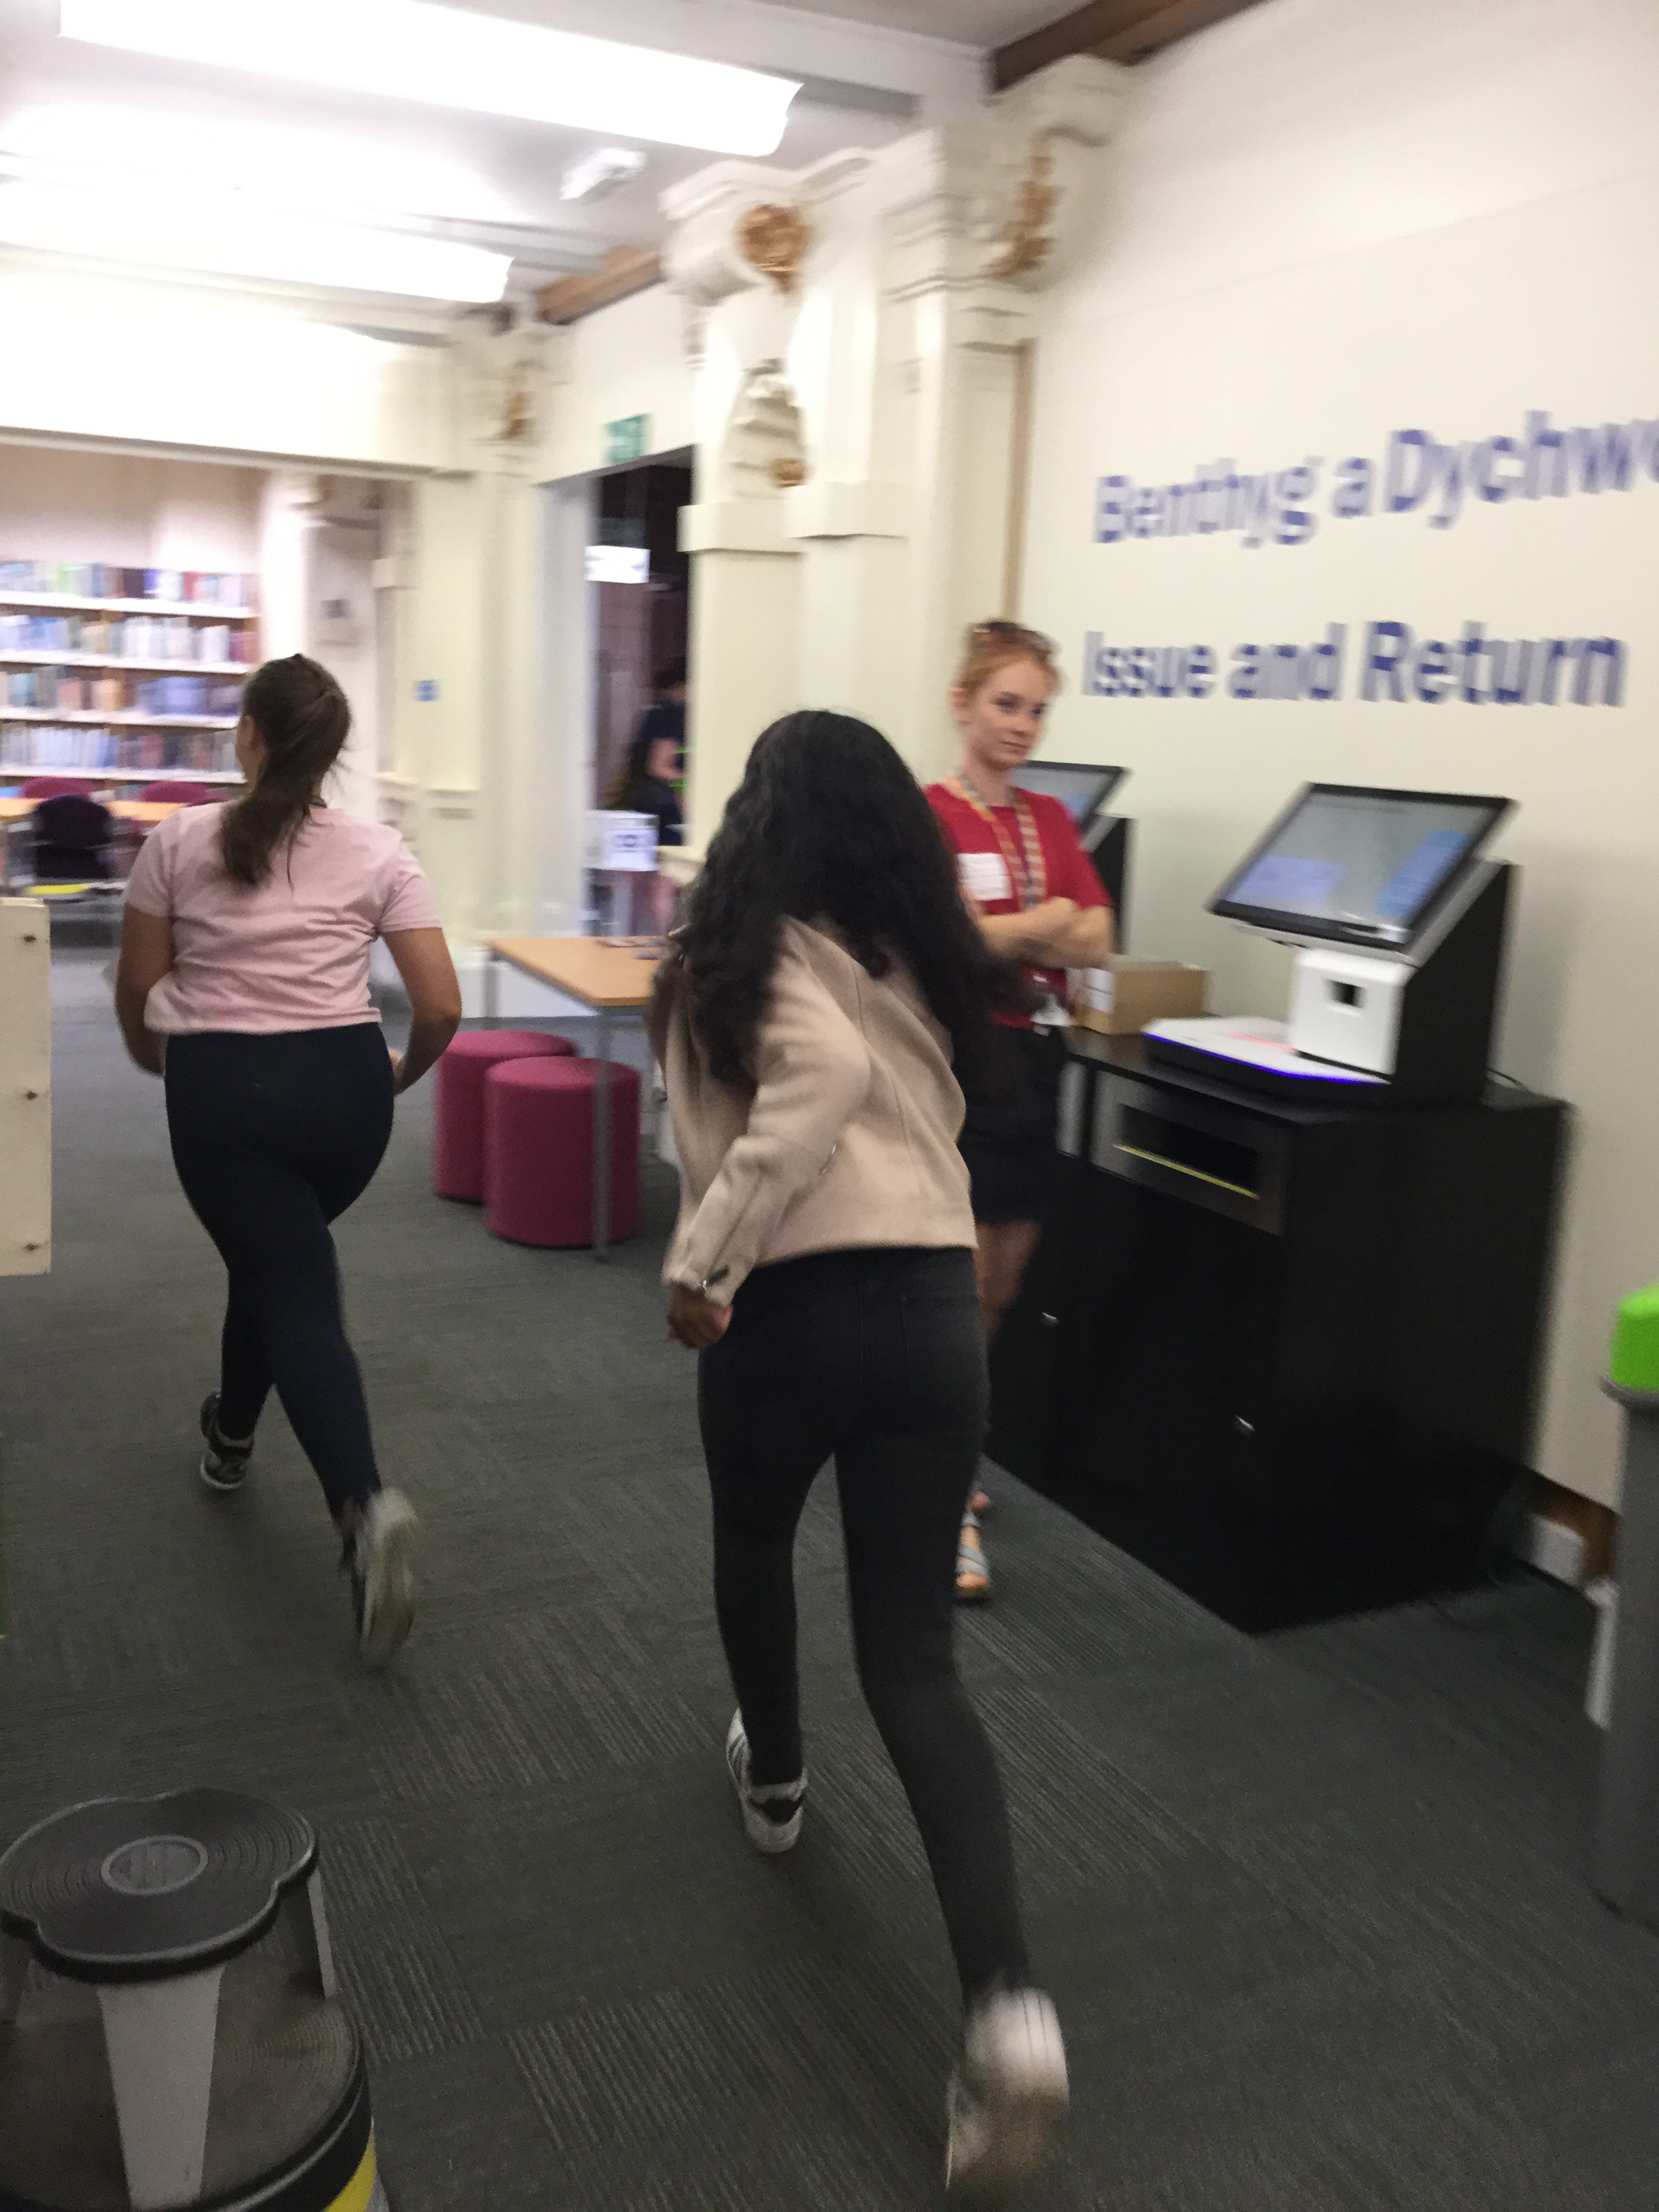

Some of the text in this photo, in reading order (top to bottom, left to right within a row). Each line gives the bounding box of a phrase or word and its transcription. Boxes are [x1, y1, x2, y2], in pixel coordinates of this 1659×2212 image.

[1332, 457, 1376, 519] a
[1083, 620, 1628, 708] Issue and Return
